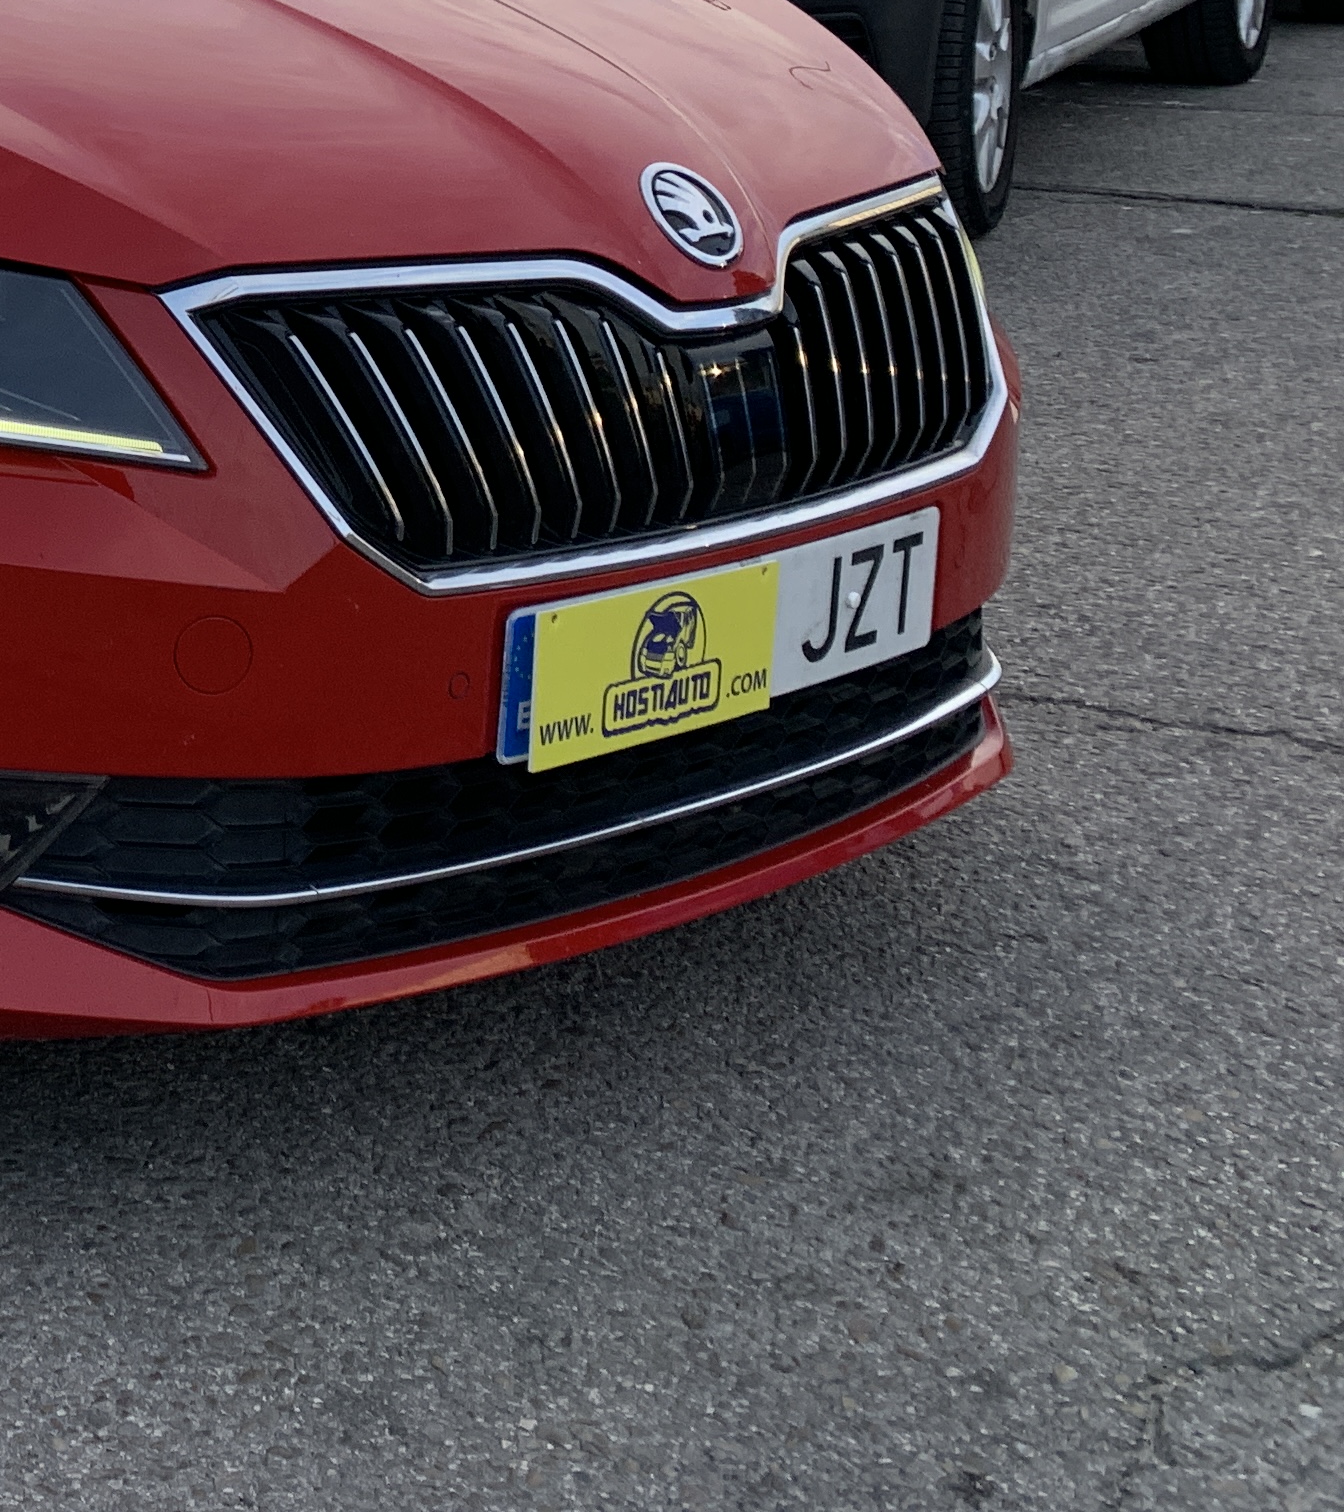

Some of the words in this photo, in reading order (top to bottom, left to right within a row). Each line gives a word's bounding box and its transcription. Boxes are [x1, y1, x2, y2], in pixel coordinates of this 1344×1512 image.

[801, 531, 924, 663] JZT
[539, 713, 595, 746] WWW.
[613, 671, 711, 722] HOSTIAUTO
[725, 668, 768, 699] .COM
